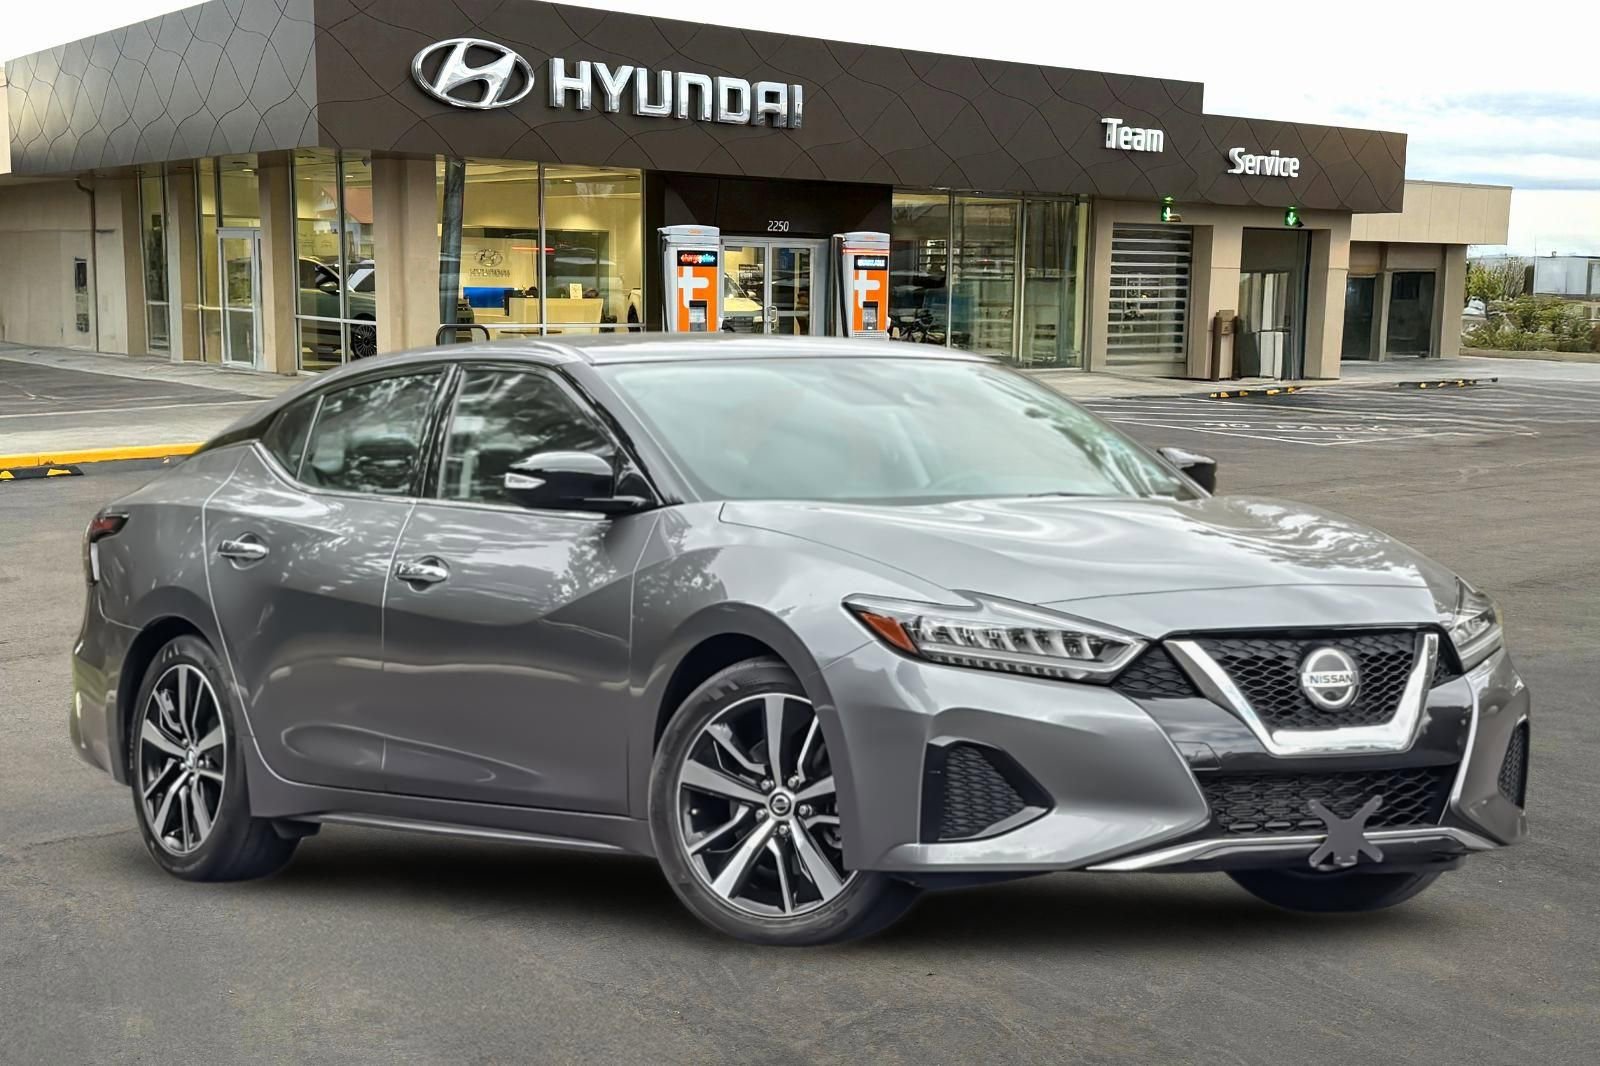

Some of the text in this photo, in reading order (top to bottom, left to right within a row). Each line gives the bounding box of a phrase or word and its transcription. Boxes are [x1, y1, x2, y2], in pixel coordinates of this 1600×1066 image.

[549, 57, 803, 129] HYUNDAI
[1101, 117, 1164, 152] Team
[1227, 147, 1300, 178] Service
[767, 220, 790, 232] 2250
[1309, 674, 1353, 685] NISSAN
